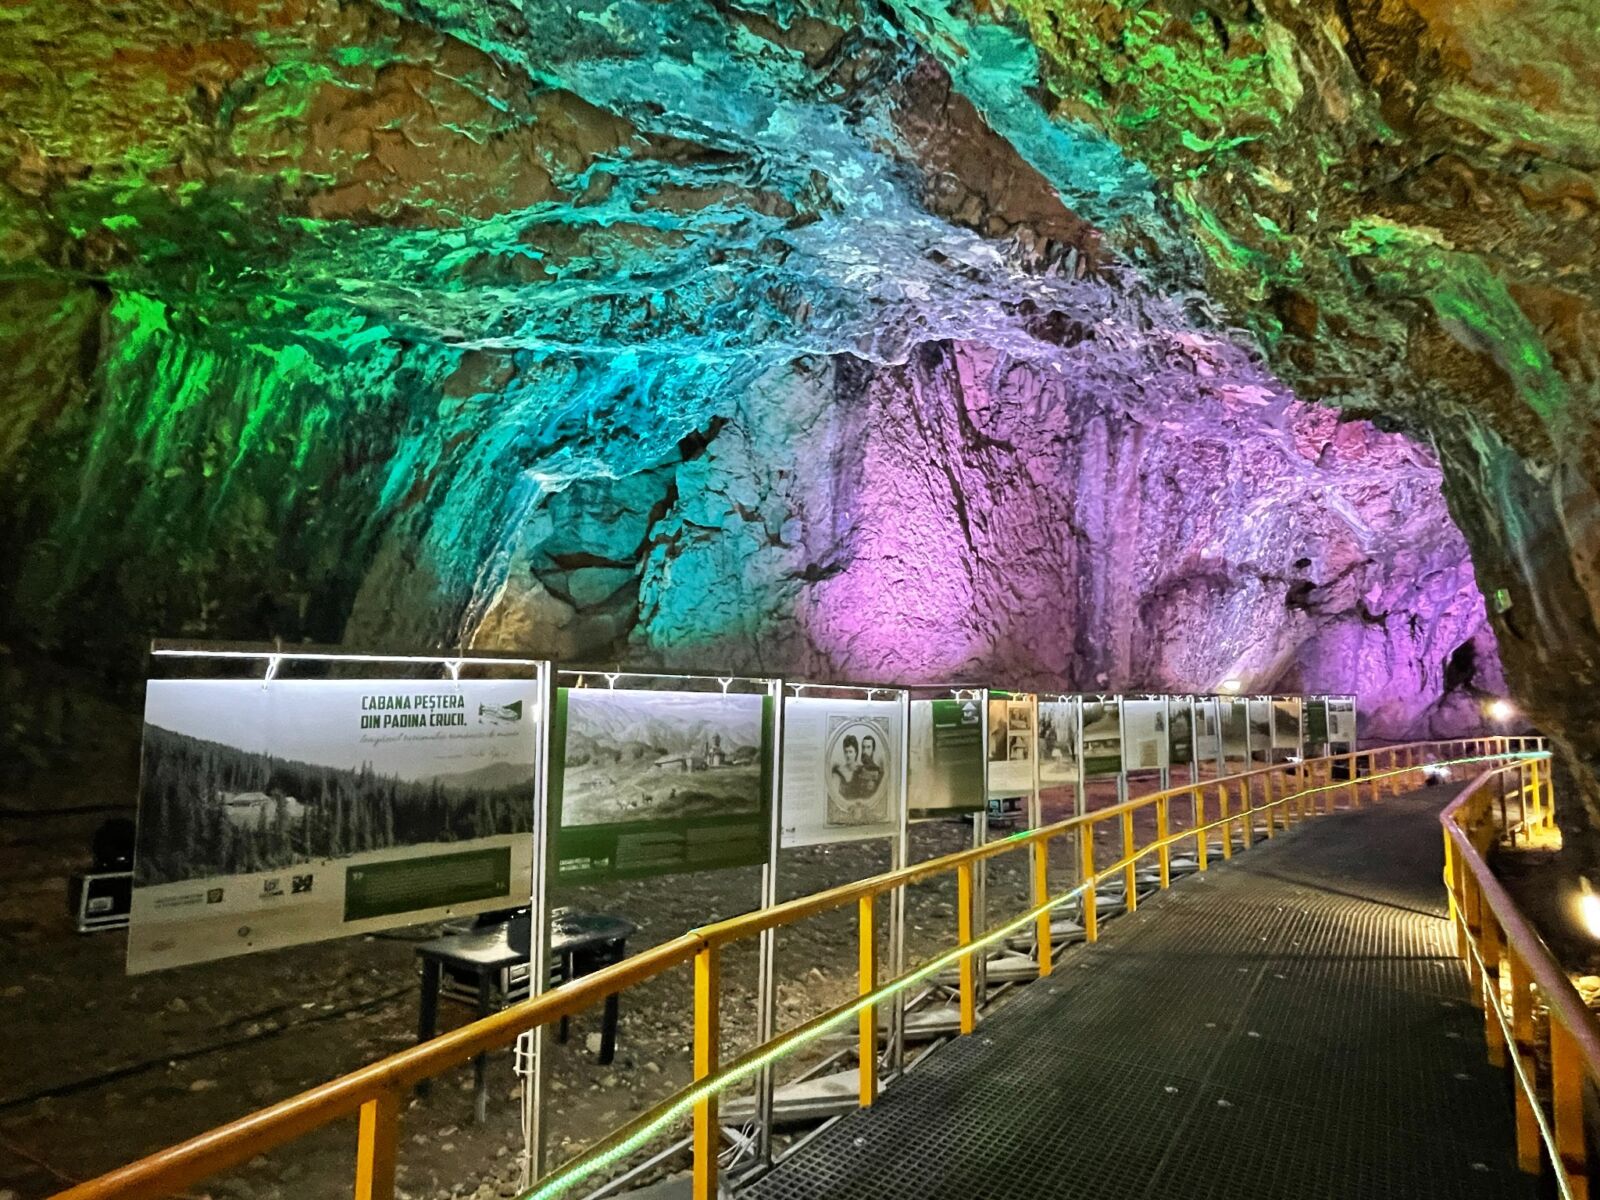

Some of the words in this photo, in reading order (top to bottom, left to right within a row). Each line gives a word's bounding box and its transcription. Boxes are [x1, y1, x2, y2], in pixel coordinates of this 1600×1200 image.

[361, 695, 411, 710] CABANA
[360, 715, 381, 729] DIN
[383, 713, 427, 728] PADINA
[429, 713, 467, 727] CRUCII.
